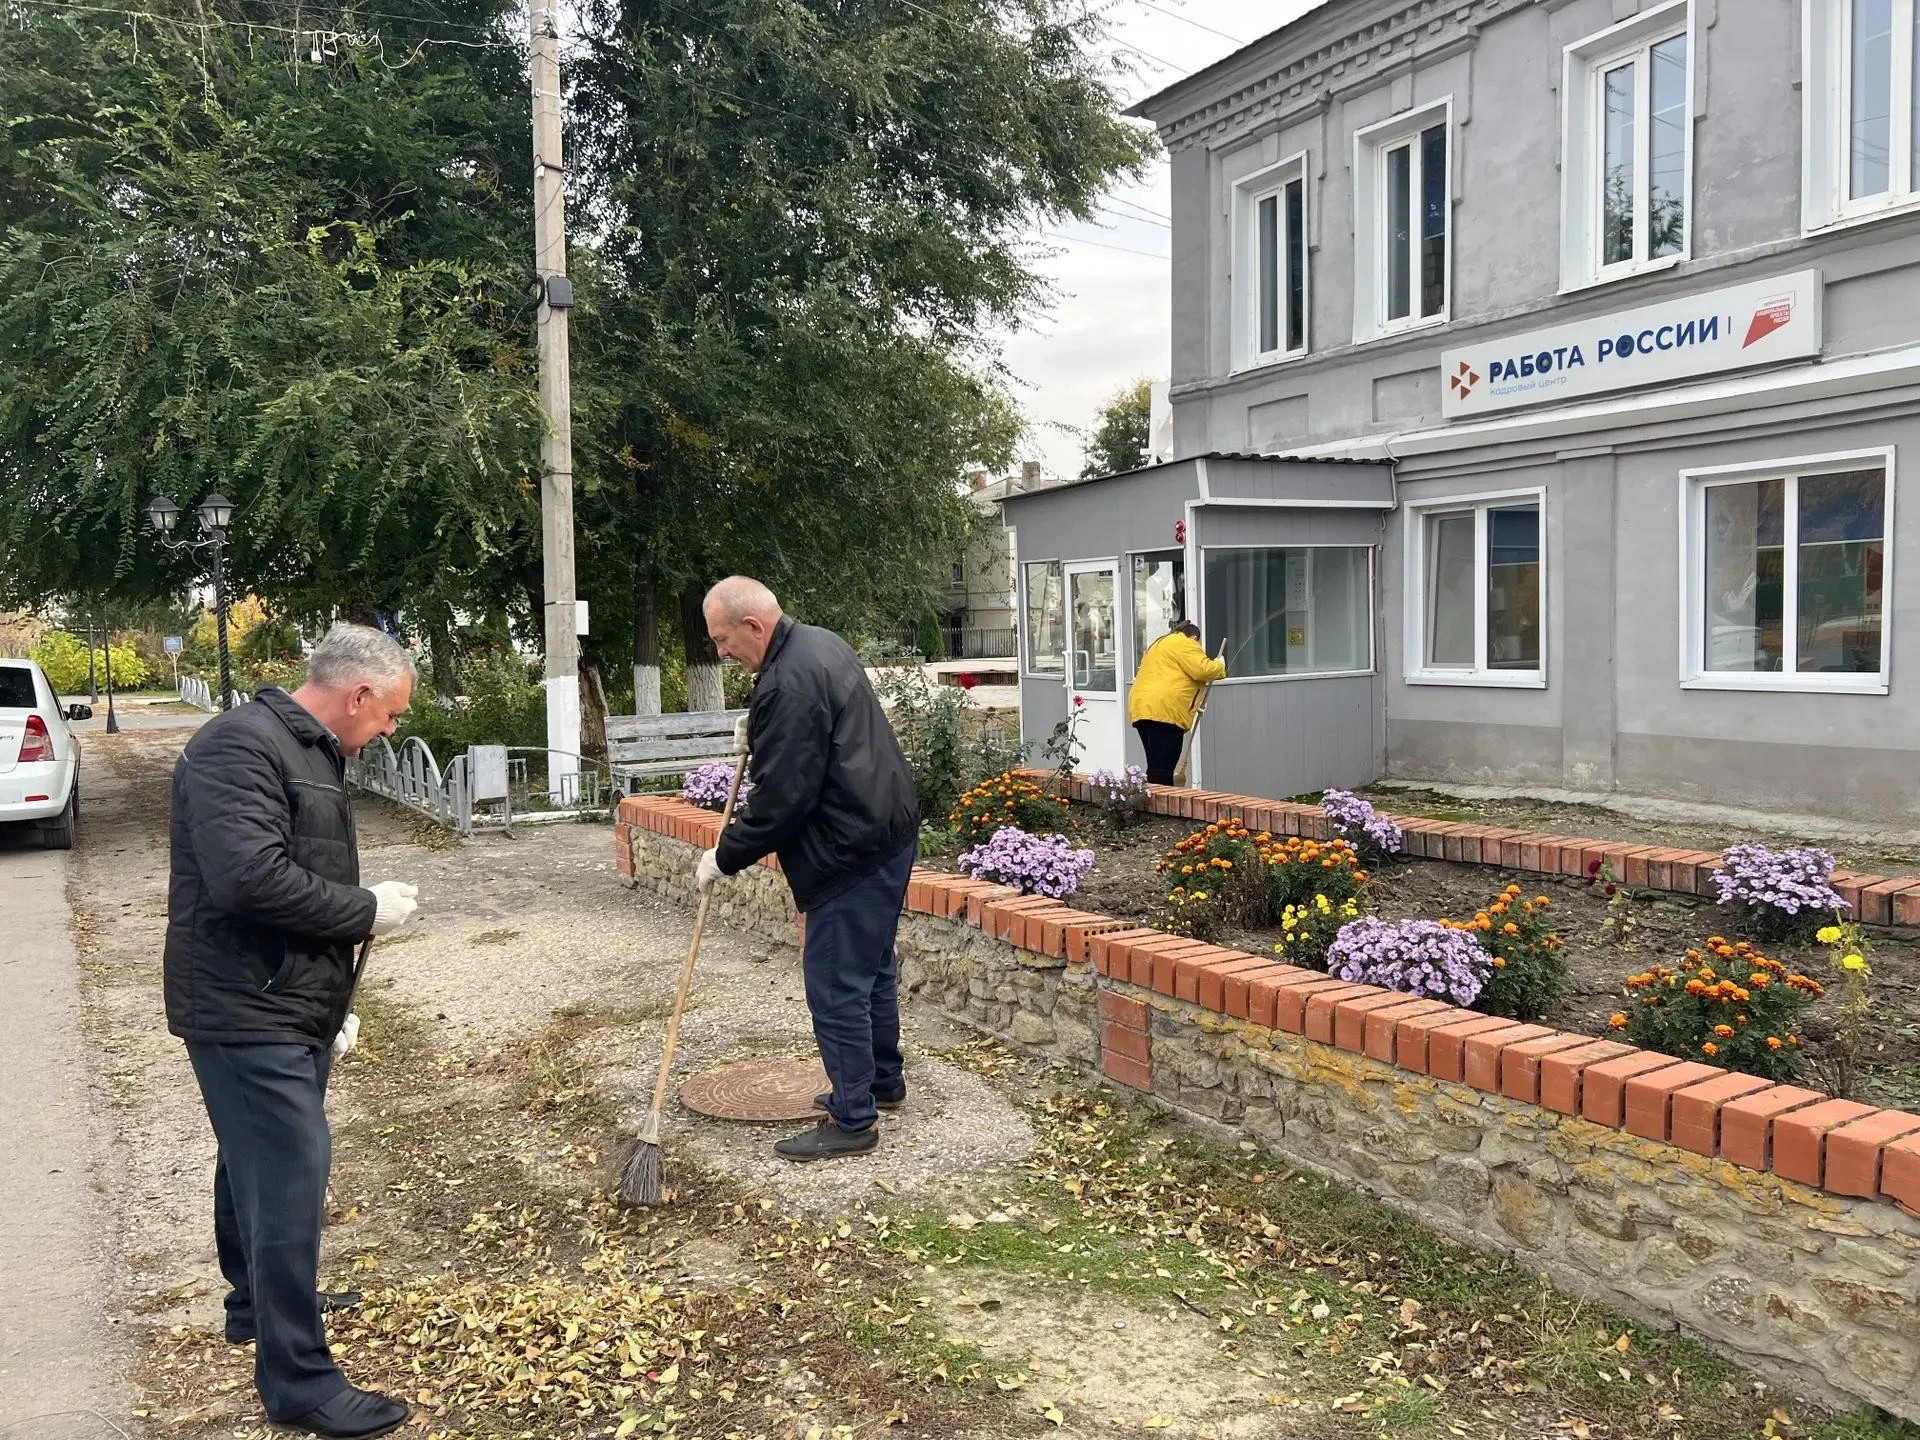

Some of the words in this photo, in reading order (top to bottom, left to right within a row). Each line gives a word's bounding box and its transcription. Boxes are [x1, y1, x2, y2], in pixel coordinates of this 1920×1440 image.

[1489, 344, 1585, 384] РАБОТА
[1598, 315, 1719, 363] РОССИИ
[1490, 381, 1536, 396] Кадровый
[1538, 376, 1567, 389] центр
